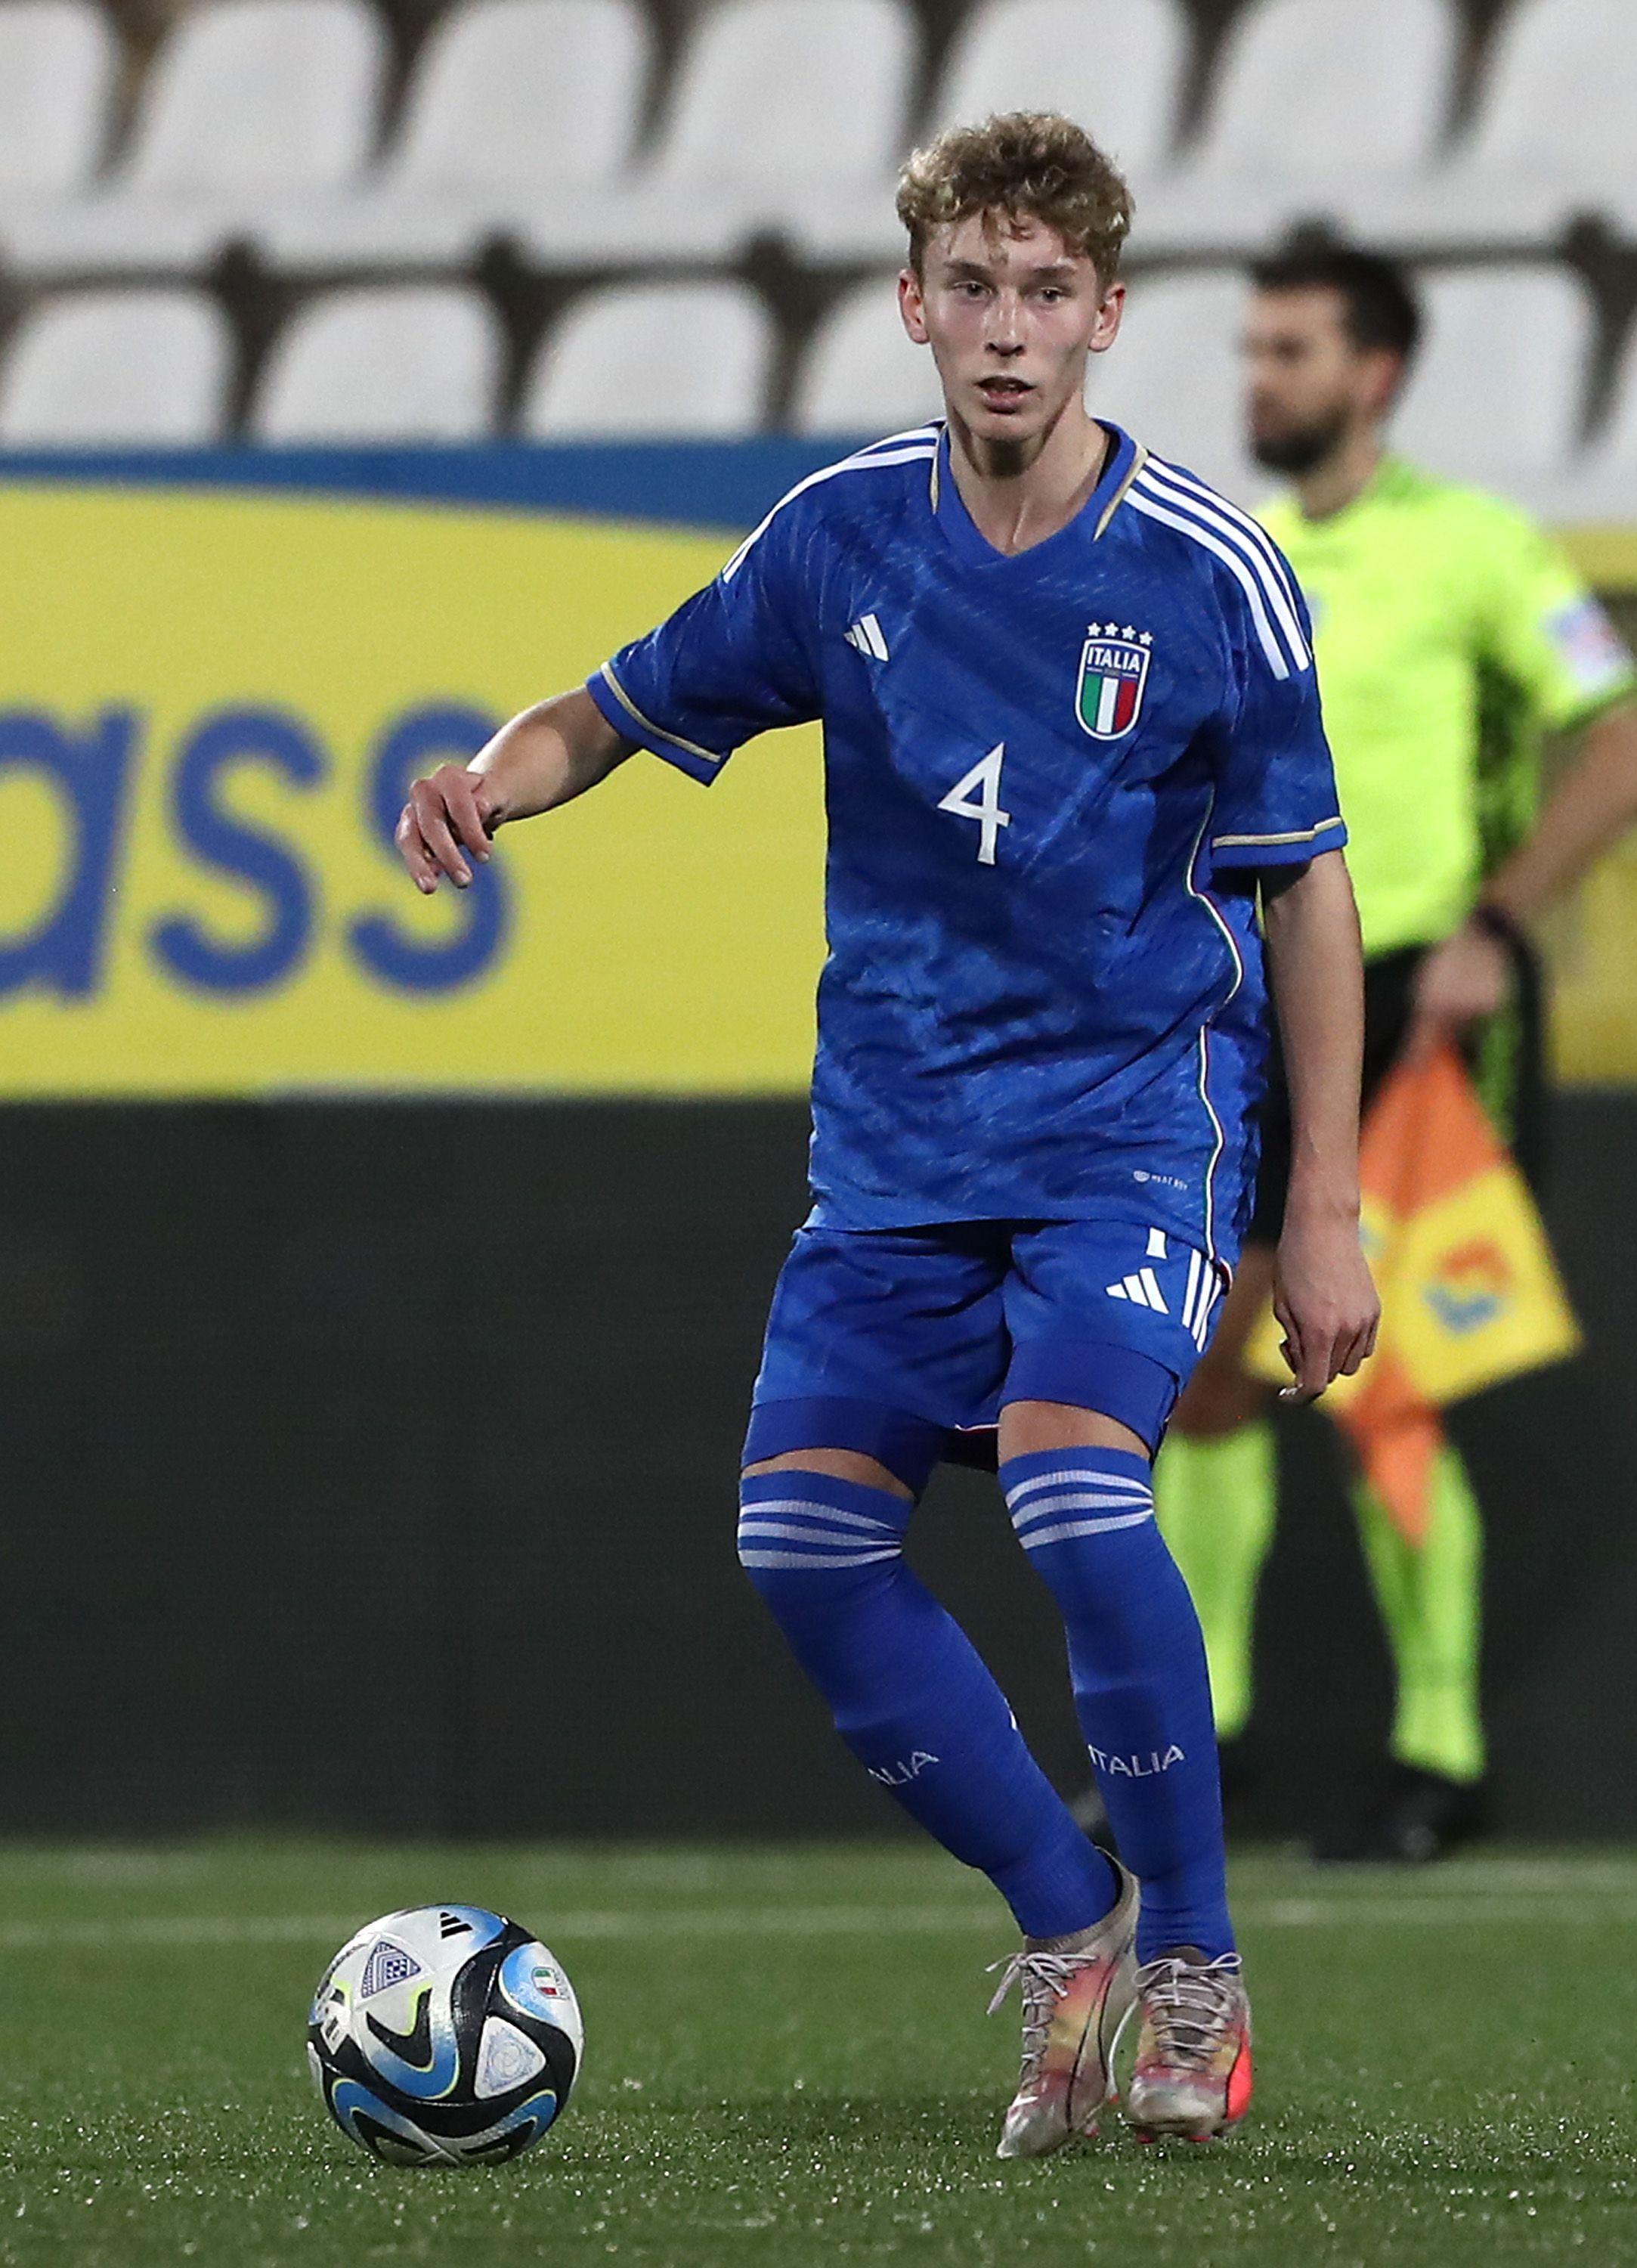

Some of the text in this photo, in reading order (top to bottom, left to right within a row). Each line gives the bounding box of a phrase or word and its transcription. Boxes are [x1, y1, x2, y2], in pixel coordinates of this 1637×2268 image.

[1087, 646, 1141, 673] ITALIA
[936, 740, 1011, 866] 4
[1087, 1743, 1185, 1777] ITALIA
